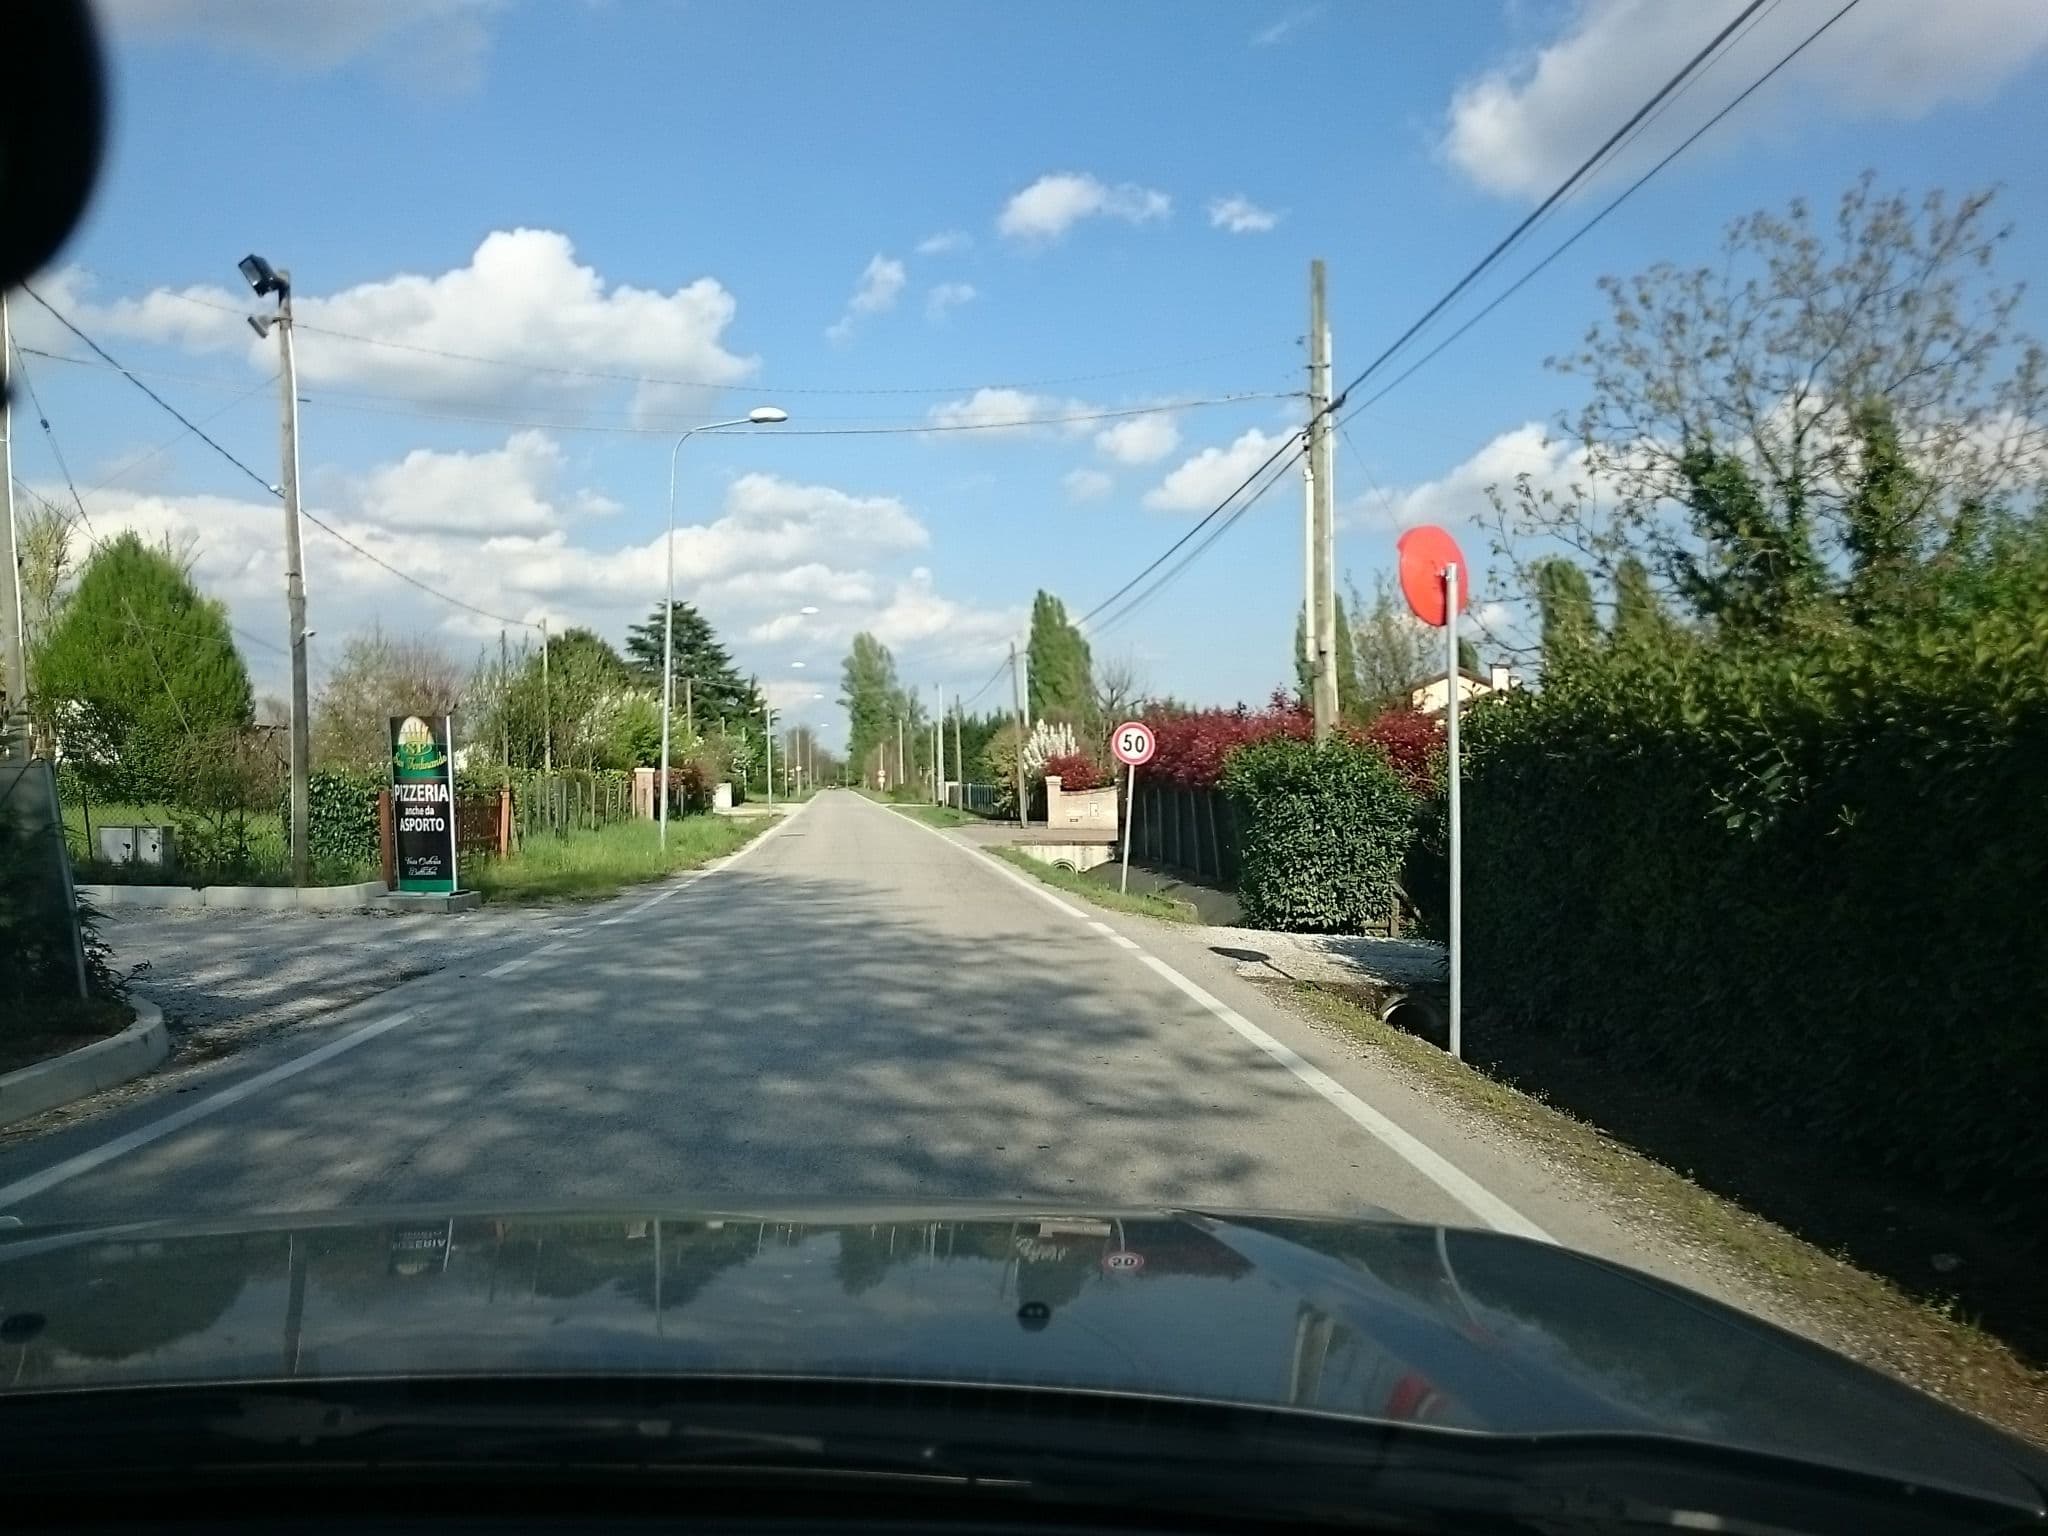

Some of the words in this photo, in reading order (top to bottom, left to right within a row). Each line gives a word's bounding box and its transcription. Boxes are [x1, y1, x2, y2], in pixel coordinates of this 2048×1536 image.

[1123, 734, 1145, 753] 50
[394, 784, 449, 802] PIZZERIA
[405, 805, 424, 815] anche
[425, 805, 435, 815] da
[400, 818, 445, 832] ASPORTO
